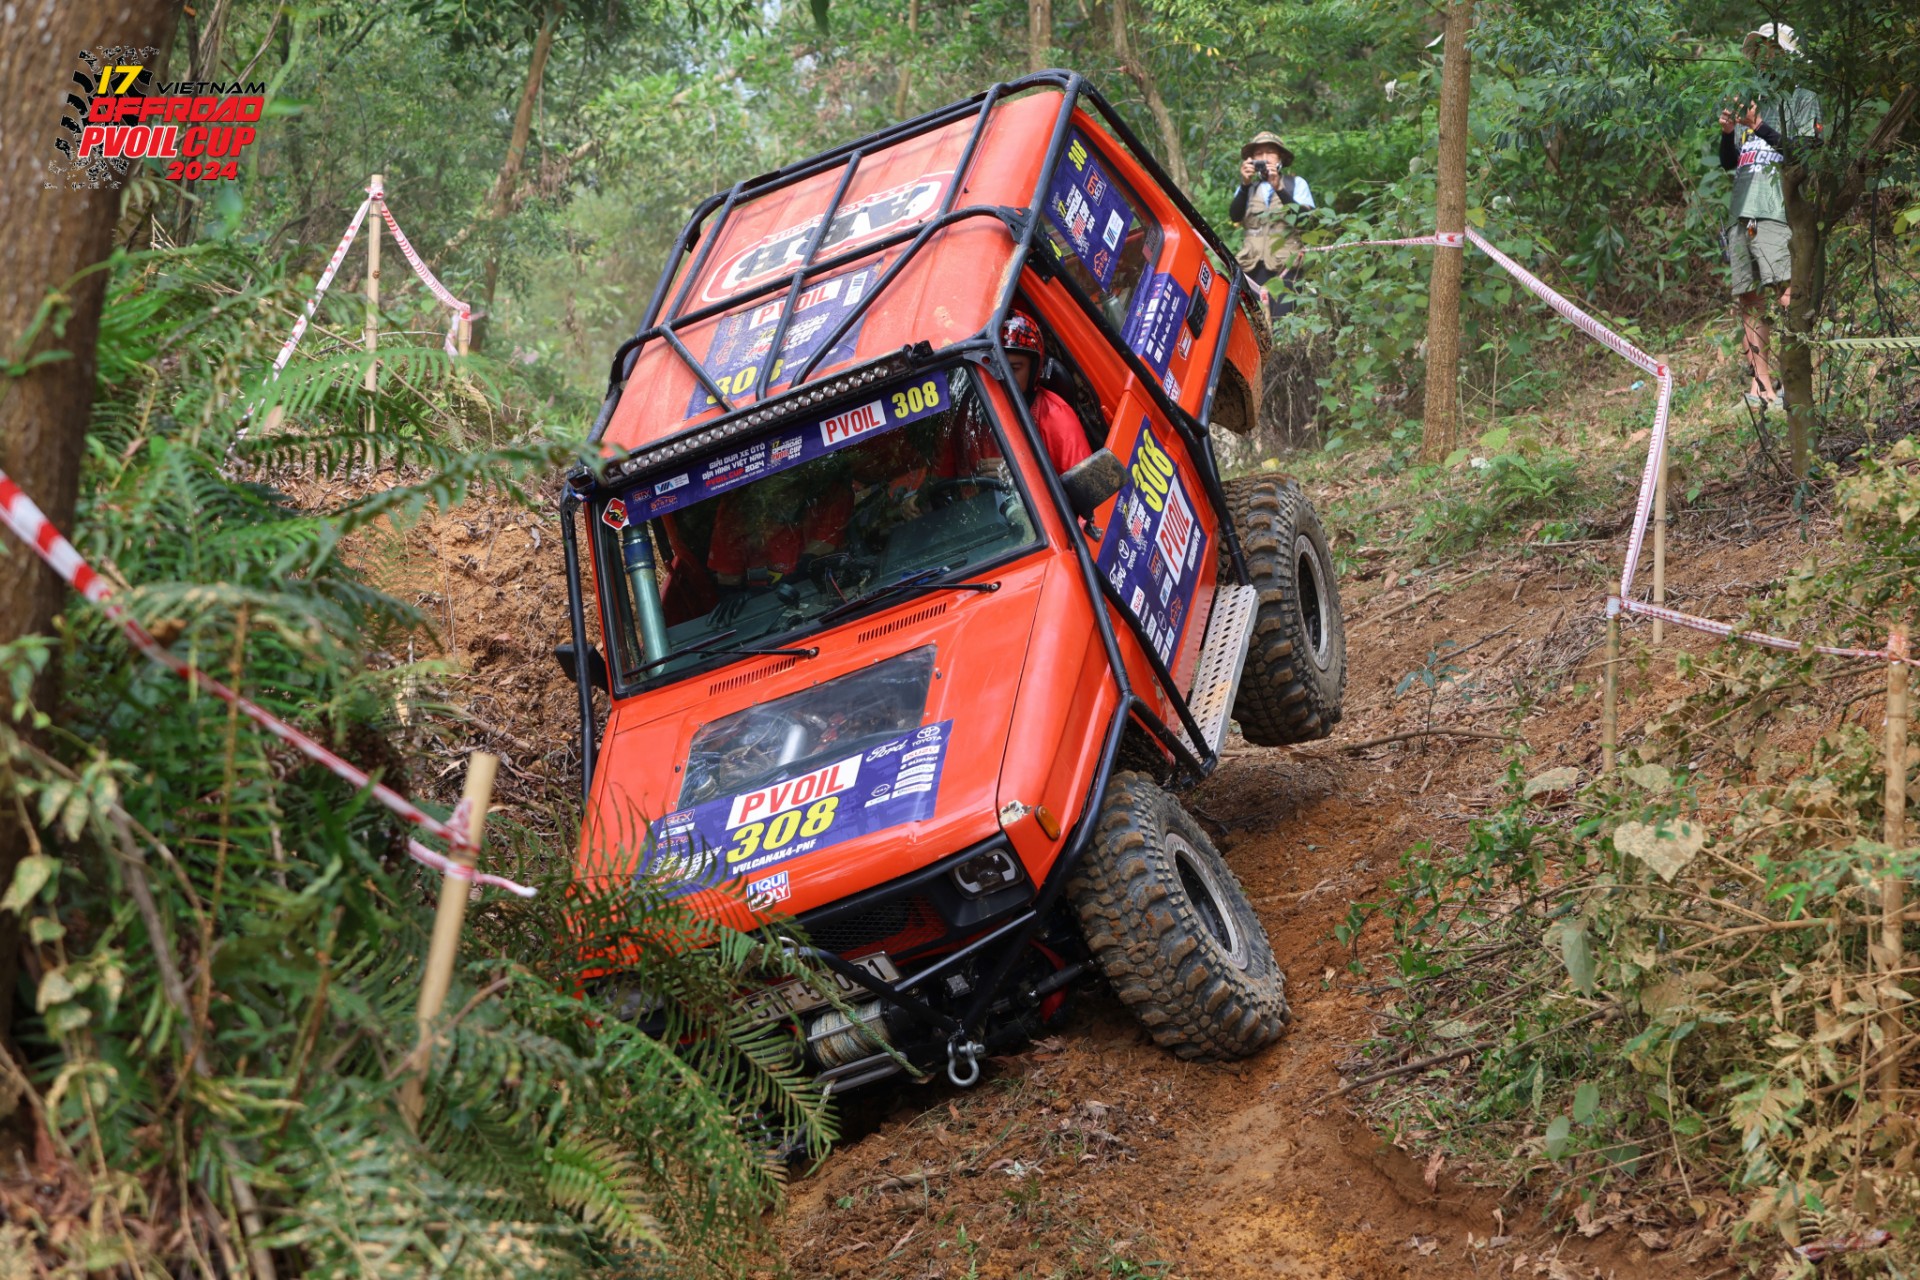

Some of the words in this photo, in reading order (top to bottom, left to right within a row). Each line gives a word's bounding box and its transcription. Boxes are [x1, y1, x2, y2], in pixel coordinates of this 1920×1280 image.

[1068, 139, 1088, 172] 308
[891, 381, 939, 419] 308
[825, 405, 880, 443] PVOIL
[745, 460, 765, 473] 2024
[1132, 428, 1174, 512] 308
[1160, 491, 1189, 573] PVOIL
[866, 739, 908, 762] Ford
[905, 747, 937, 760] ISUZU
[912, 736, 942, 747] TOYOTA
[739, 765, 844, 824] PVOIL
[727, 796, 839, 863] 308
[749, 873, 786, 898] LIQUI
[751, 885, 787, 906] MOLY
